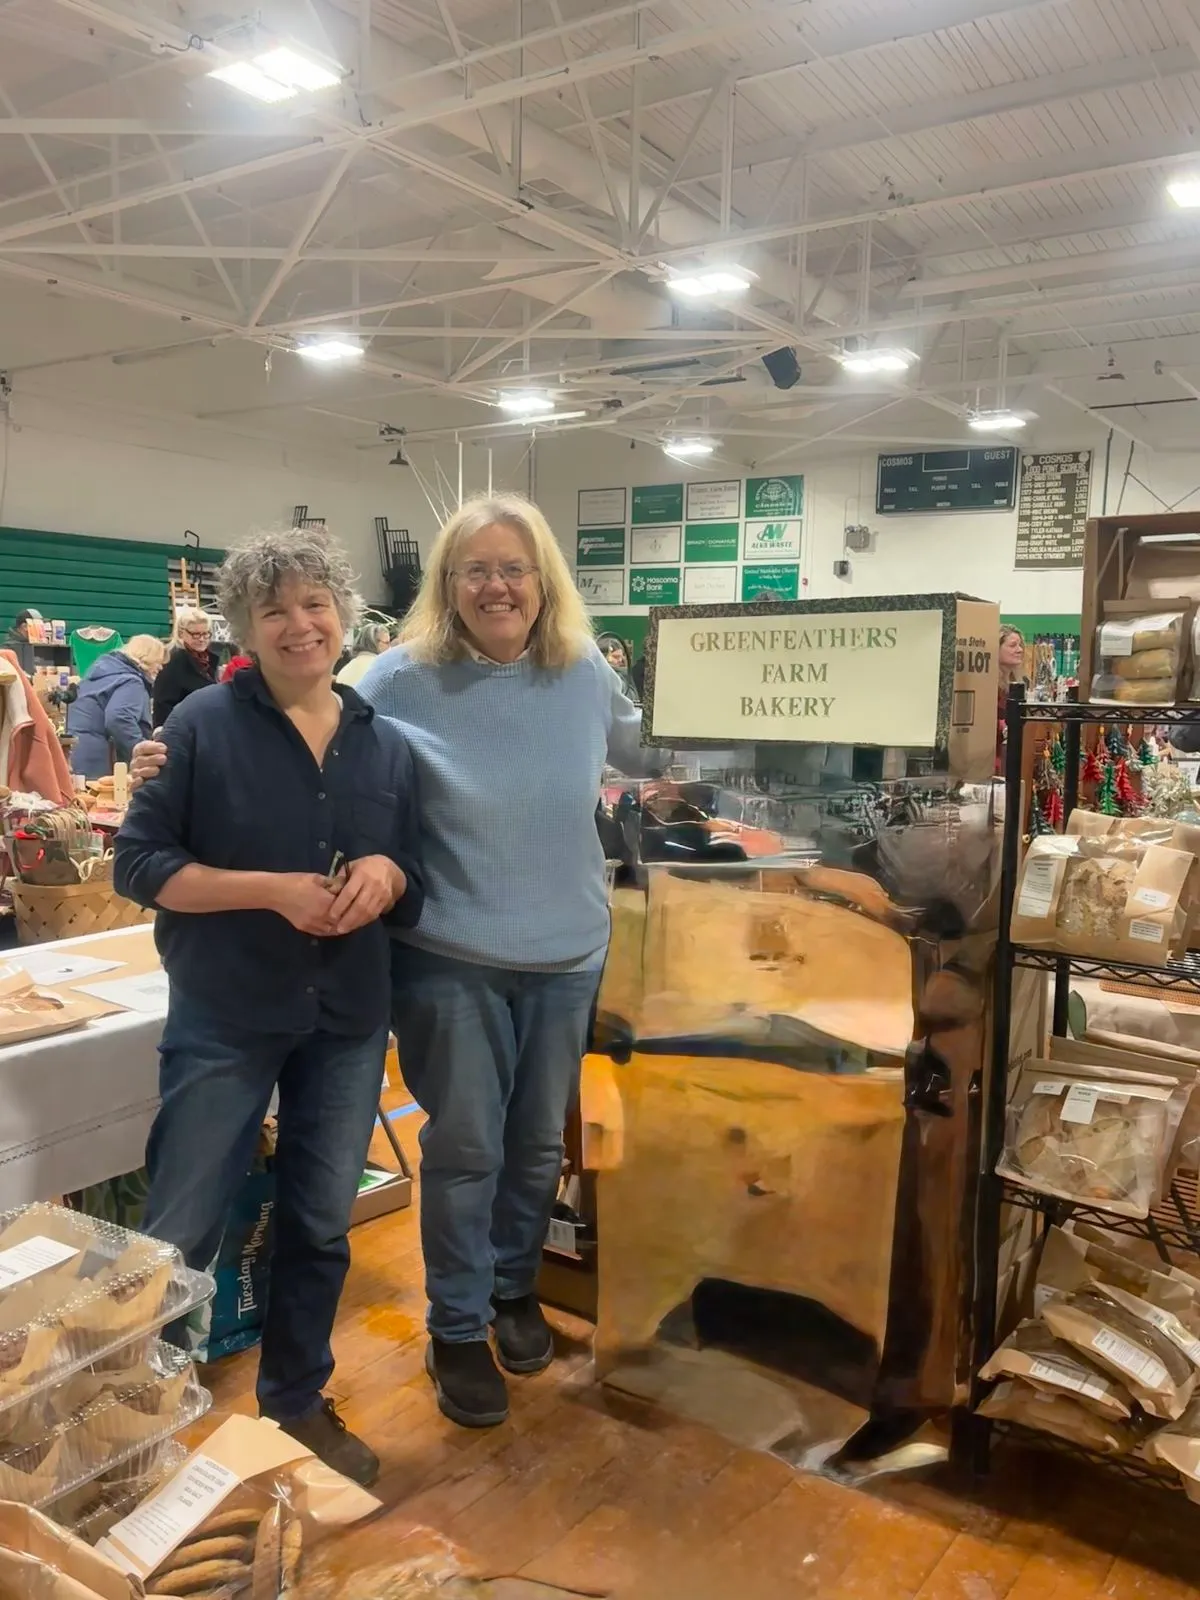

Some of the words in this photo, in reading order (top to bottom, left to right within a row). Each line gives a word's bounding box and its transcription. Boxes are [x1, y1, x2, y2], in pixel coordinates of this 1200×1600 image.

[882, 456, 913, 467] COSMOS
[984, 450, 1011, 461] GUEST
[1039, 454, 1073, 464] COSMOS
[690, 627, 897, 652] GREENFEATHERS
[968, 637, 986, 647] State
[968, 651, 991, 673] LOT
[761, 663, 828, 684] FARM
[740, 697, 836, 717] BAKERY
[242, 1201, 275, 1256] Morning
[237, 1256, 258, 1320] Tuesday
